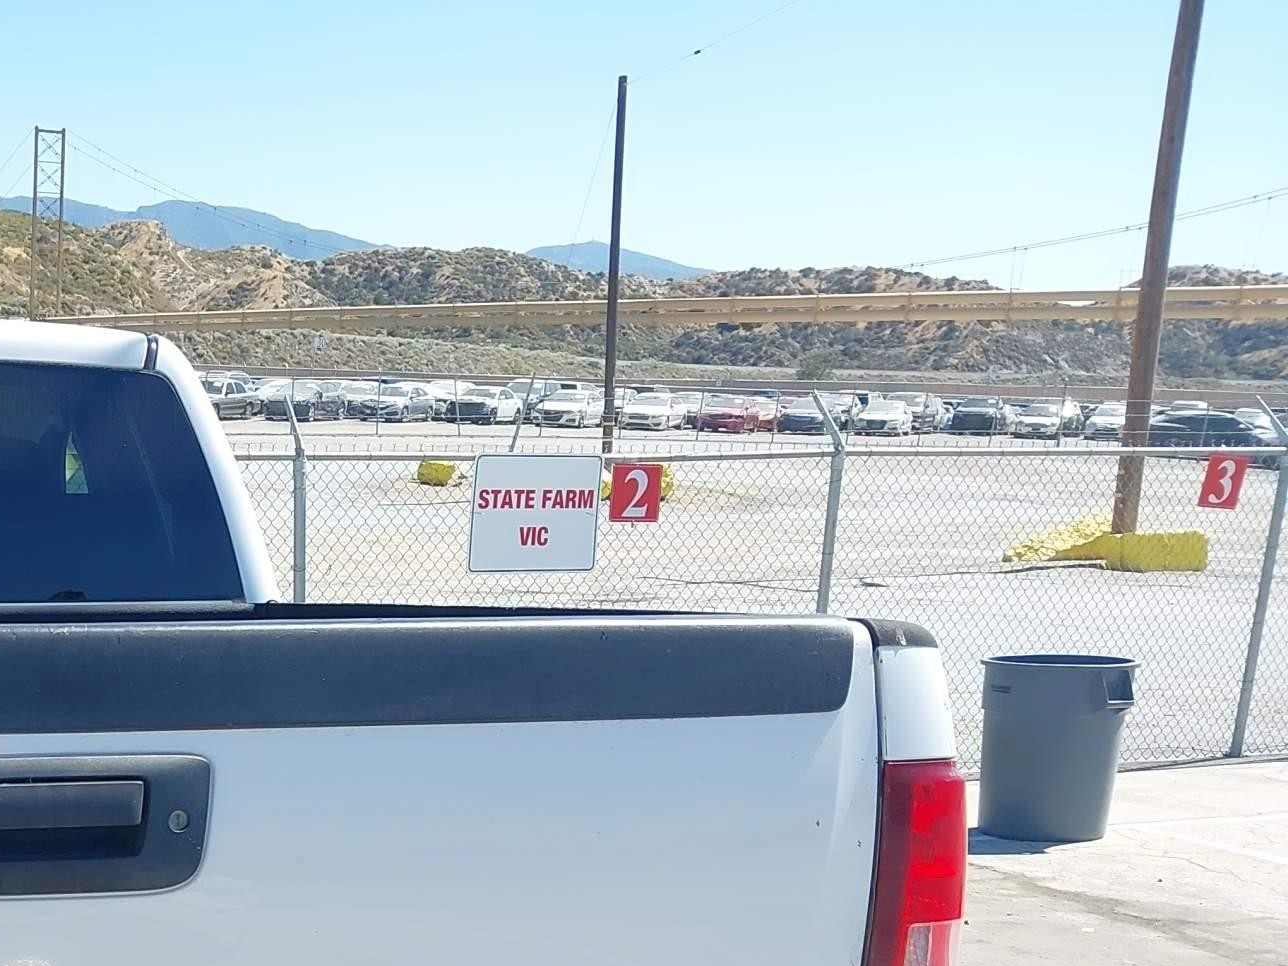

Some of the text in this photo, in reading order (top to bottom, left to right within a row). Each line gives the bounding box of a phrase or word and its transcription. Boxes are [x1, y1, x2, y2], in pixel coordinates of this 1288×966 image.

[621, 469, 649, 518] 2
[1208, 459, 1236, 504] 3
[478, 489, 594, 509] STATE FARM
[519, 526, 549, 546] VIC
